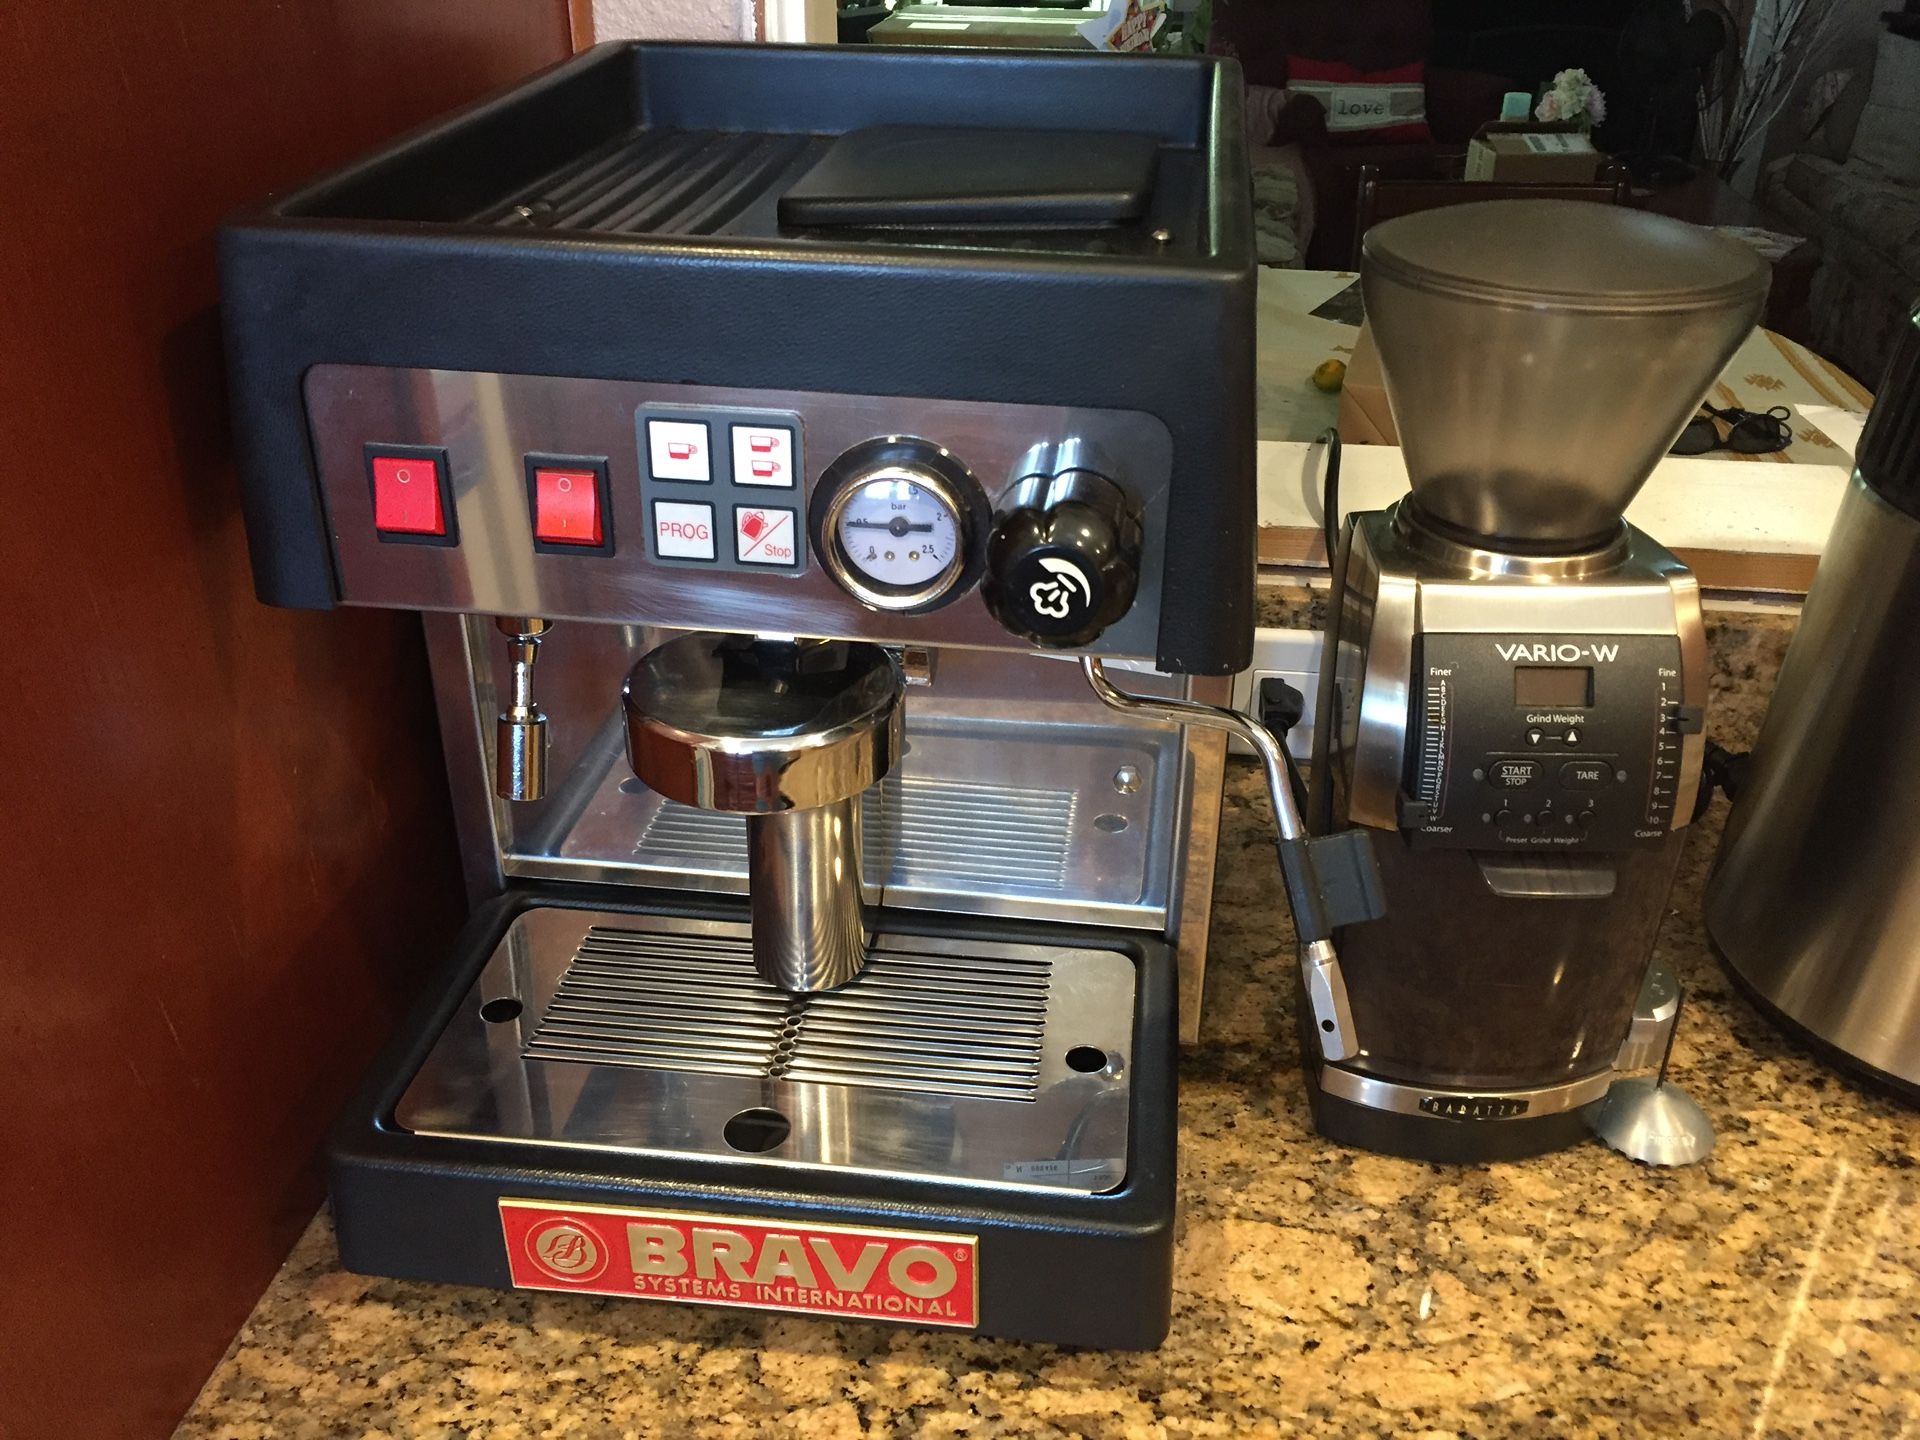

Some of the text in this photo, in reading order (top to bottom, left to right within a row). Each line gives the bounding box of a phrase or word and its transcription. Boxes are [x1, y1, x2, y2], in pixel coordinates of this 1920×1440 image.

[1337, 100, 1385, 115] love
[936, 512, 942, 522] 2
[660, 522, 709, 540] PROG
[764, 543, 792, 559] Stop
[922, 545, 934, 554] 2.5
[1495, 643, 1619, 662] VARIO-W
[1430, 667, 1452, 676] Finer
[1658, 668, 1677, 677] Fine
[1661, 682, 1666, 691] 1
[1660, 697, 1667, 707] 2
[1526, 714, 1585, 725] Grind Weight
[1660, 713, 1666, 723] 3
[1659, 727, 1665, 736] 4
[1659, 742, 1665, 751] 5
[1657, 757, 1664, 766] 6
[1501, 766, 1533, 776] START
[1576, 771, 1600, 780] TARE
[1656, 771, 1662, 780] 7
[1505, 778, 1527, 786] STOP
[1653, 786, 1661, 796] 8
[1545, 799, 1552, 808] 2
[1588, 799, 1595, 808] 3
[1651, 801, 1658, 810] 9
[1649, 816, 1660, 824] 10
[1634, 830, 1663, 838] Coarse
[626, 1221, 958, 1300] BRAVO
[633, 1275, 957, 1317] SYSTEMS INTERNATIONAL
